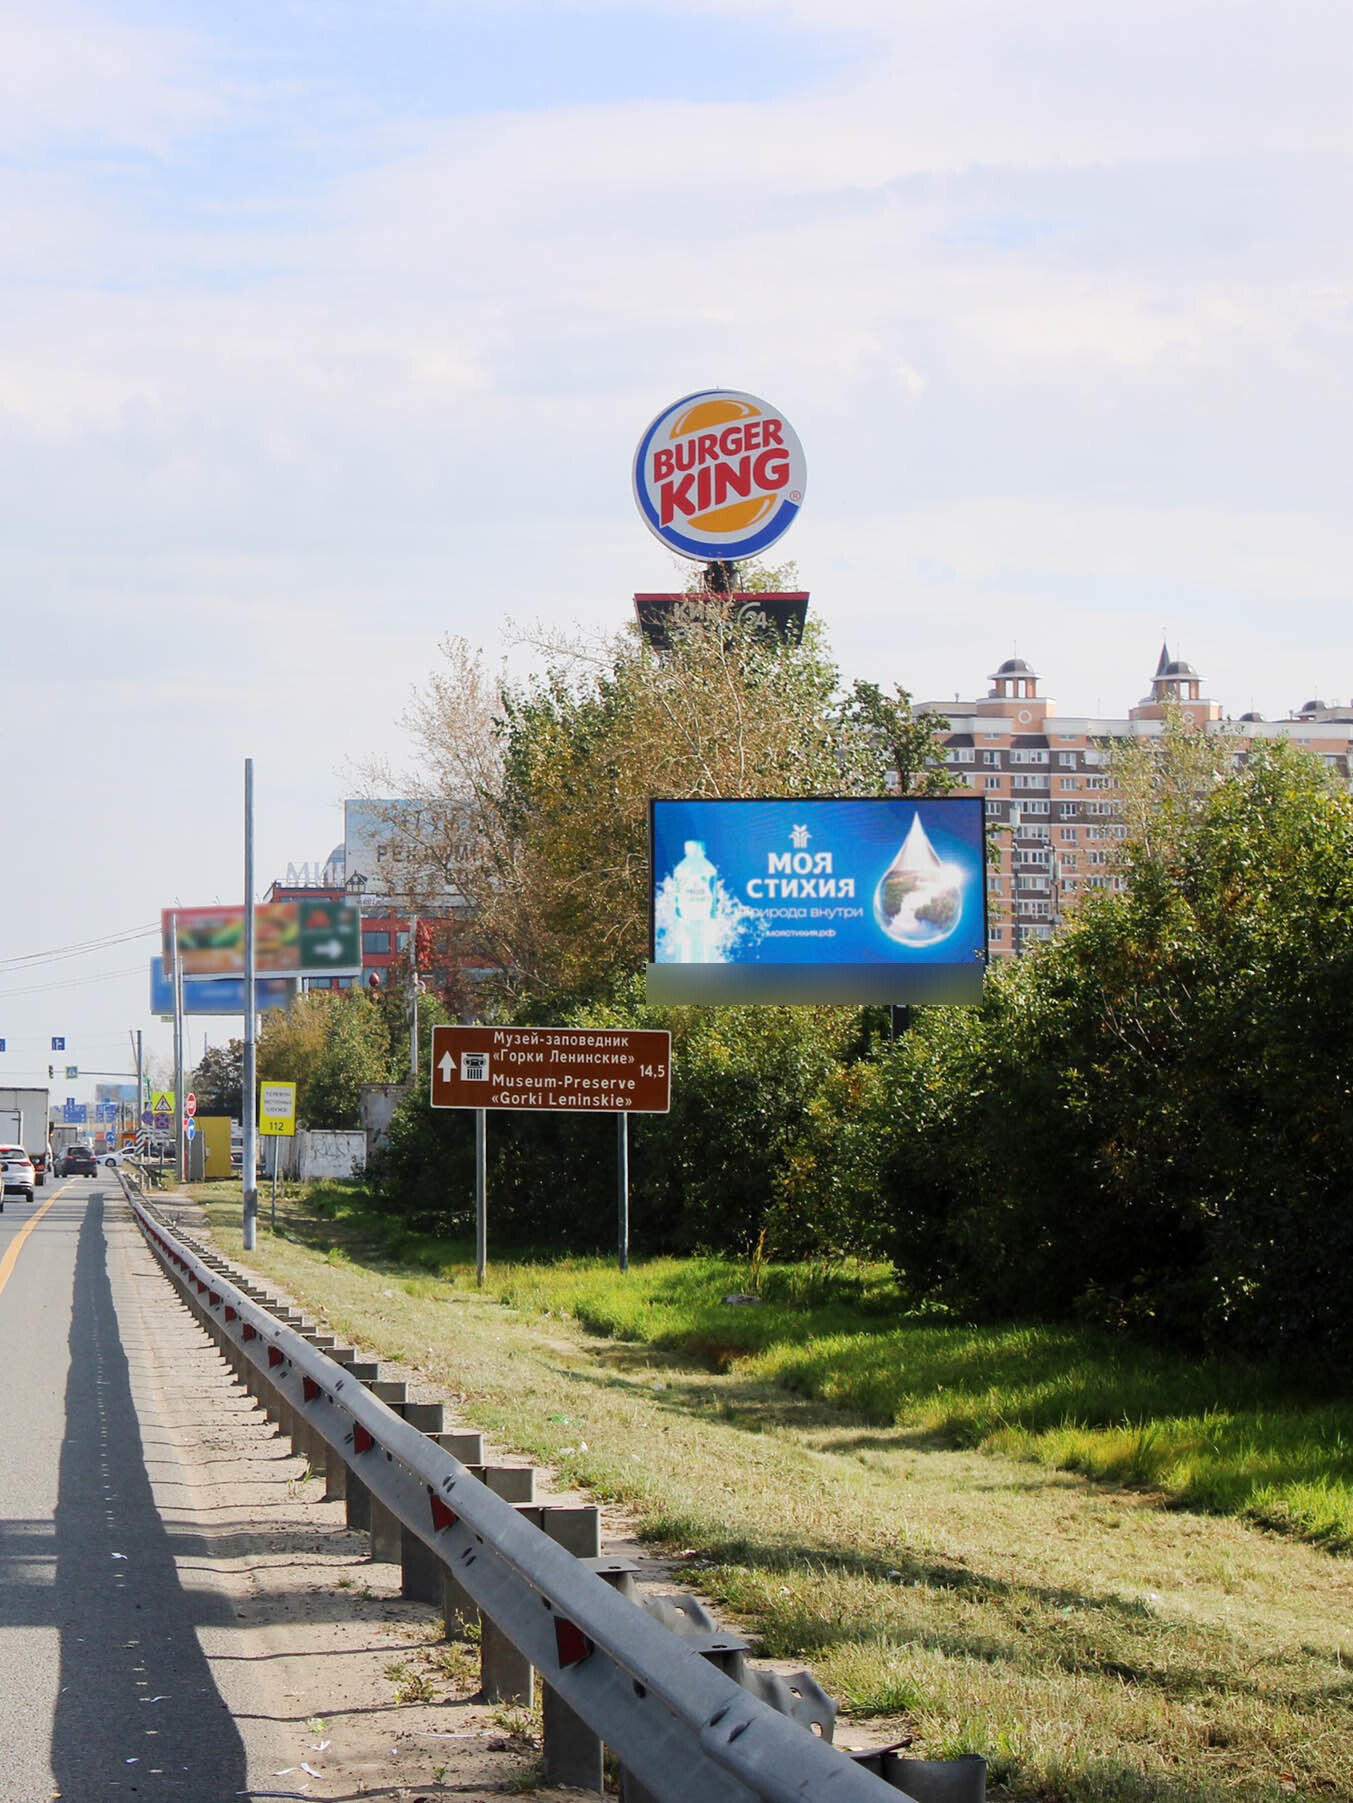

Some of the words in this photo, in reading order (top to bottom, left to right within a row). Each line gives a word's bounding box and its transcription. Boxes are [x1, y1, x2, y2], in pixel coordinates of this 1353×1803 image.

[653, 418, 784, 483] BURGER
[660, 447, 790, 526] KING
[768, 852, 833, 875] МОЯ
[746, 878, 855, 899] СТИХИЯ
[743, 906, 807, 919] рирода
[810, 906, 864, 920] внутри
[493, 1031, 629, 1048] Музей-заповедник
[493, 1049, 544, 1065] «Горки
[549, 1050, 636, 1065] Ленинские»
[639, 1064, 666, 1079] 14,5
[492, 1073, 636, 1090] Museum-Preserve
[491, 1091, 543, 1106] «Gorki
[549, 1092, 633, 1107] Leninskie»
[269, 1121, 285, 1131] 112
